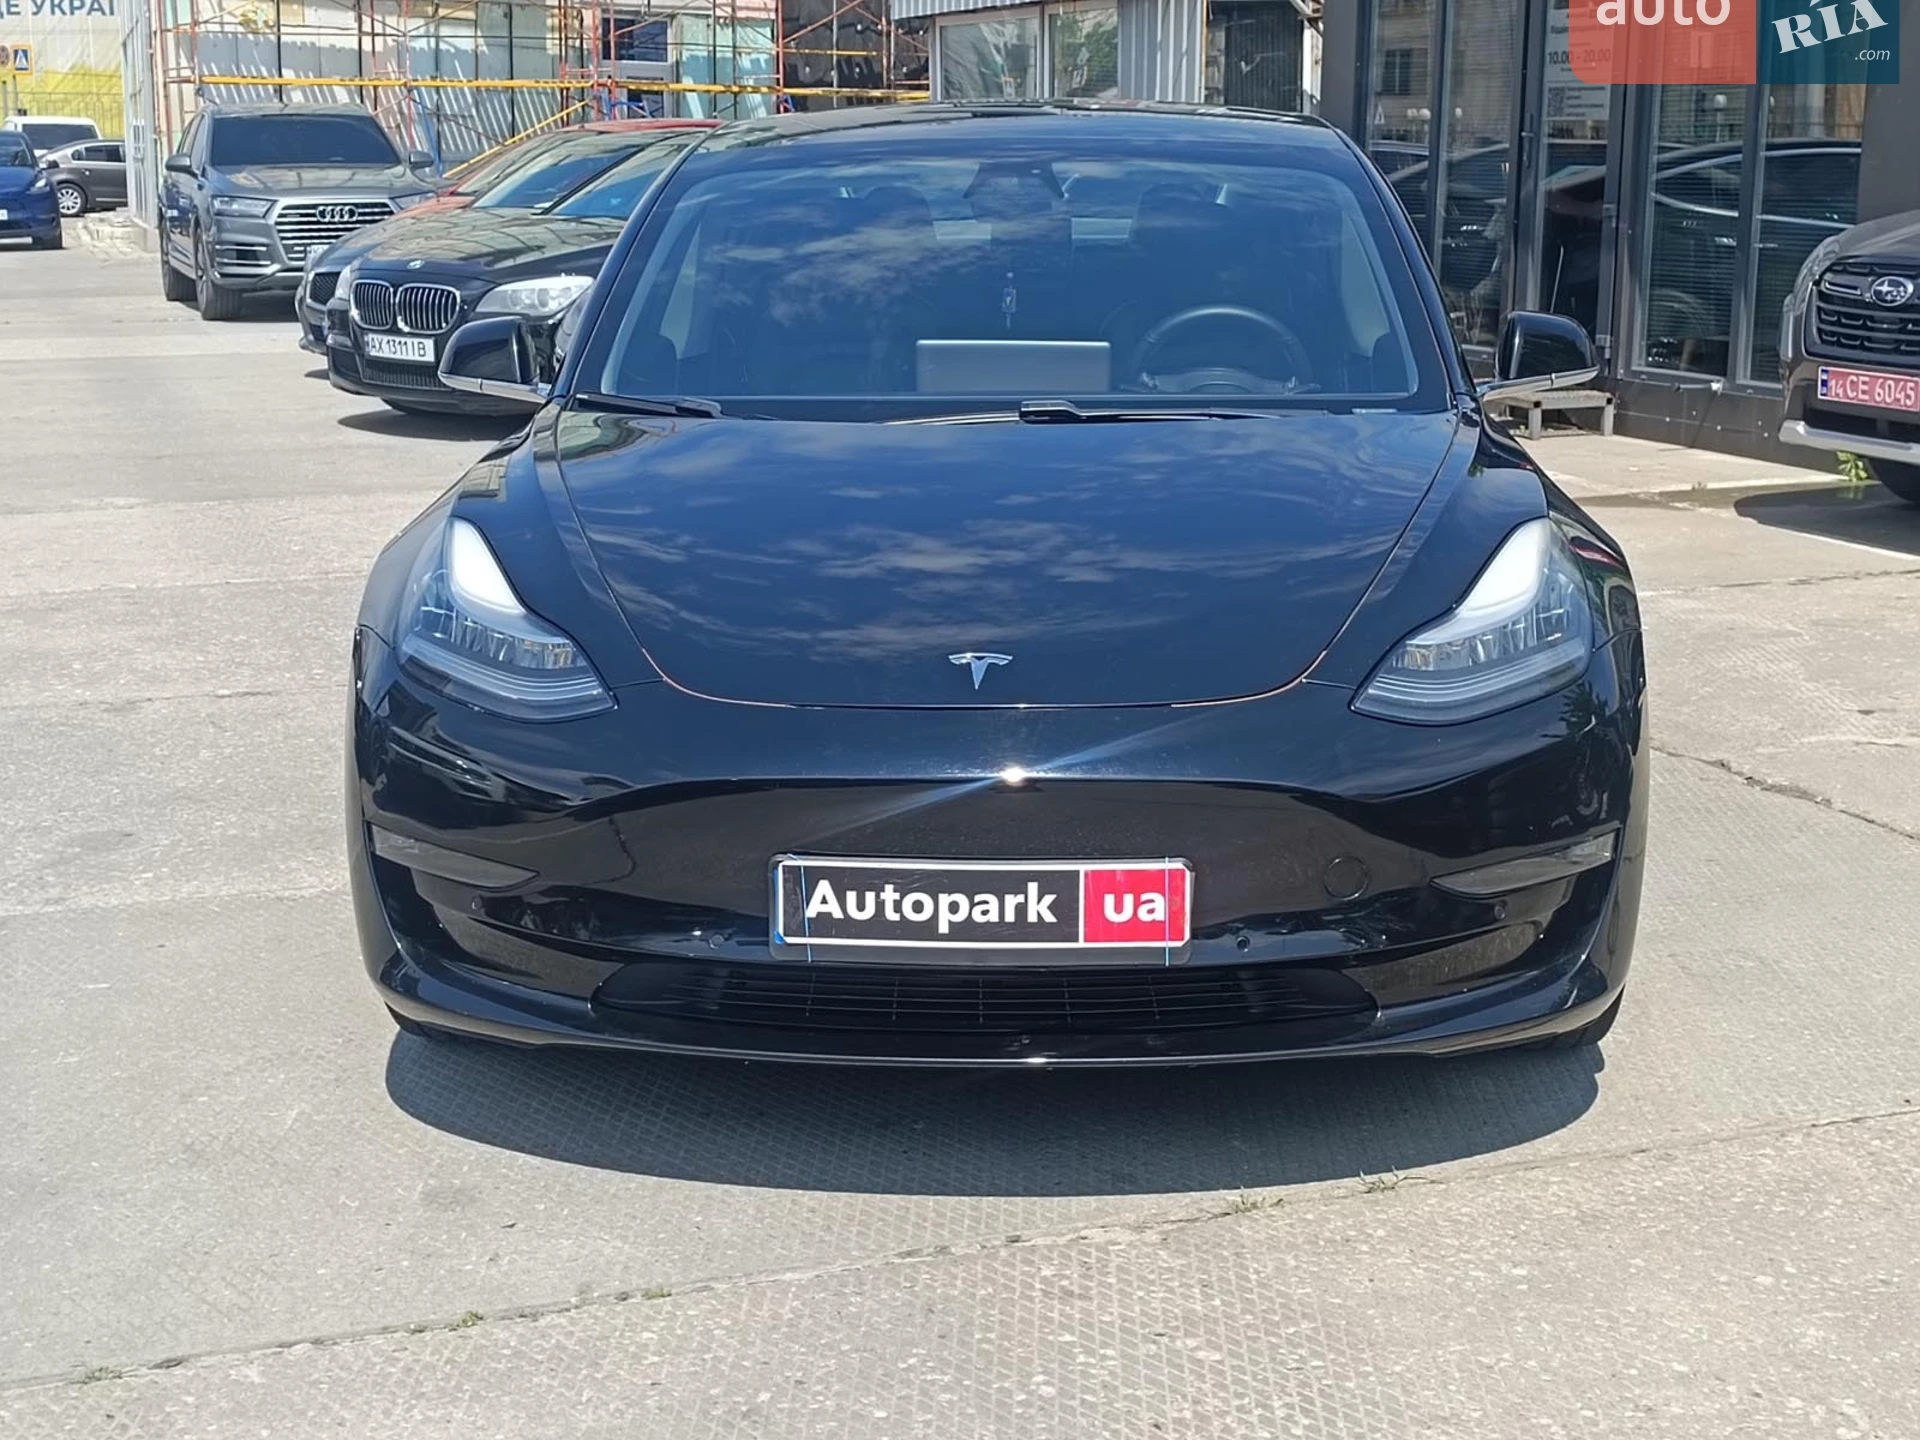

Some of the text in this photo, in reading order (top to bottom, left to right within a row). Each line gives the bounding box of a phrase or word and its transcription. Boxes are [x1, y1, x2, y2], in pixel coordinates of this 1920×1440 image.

[0, 0, 21, 19] Е
[1874, 378, 1916, 407] 6045
[805, 878, 1166, 934] Autopark ua
